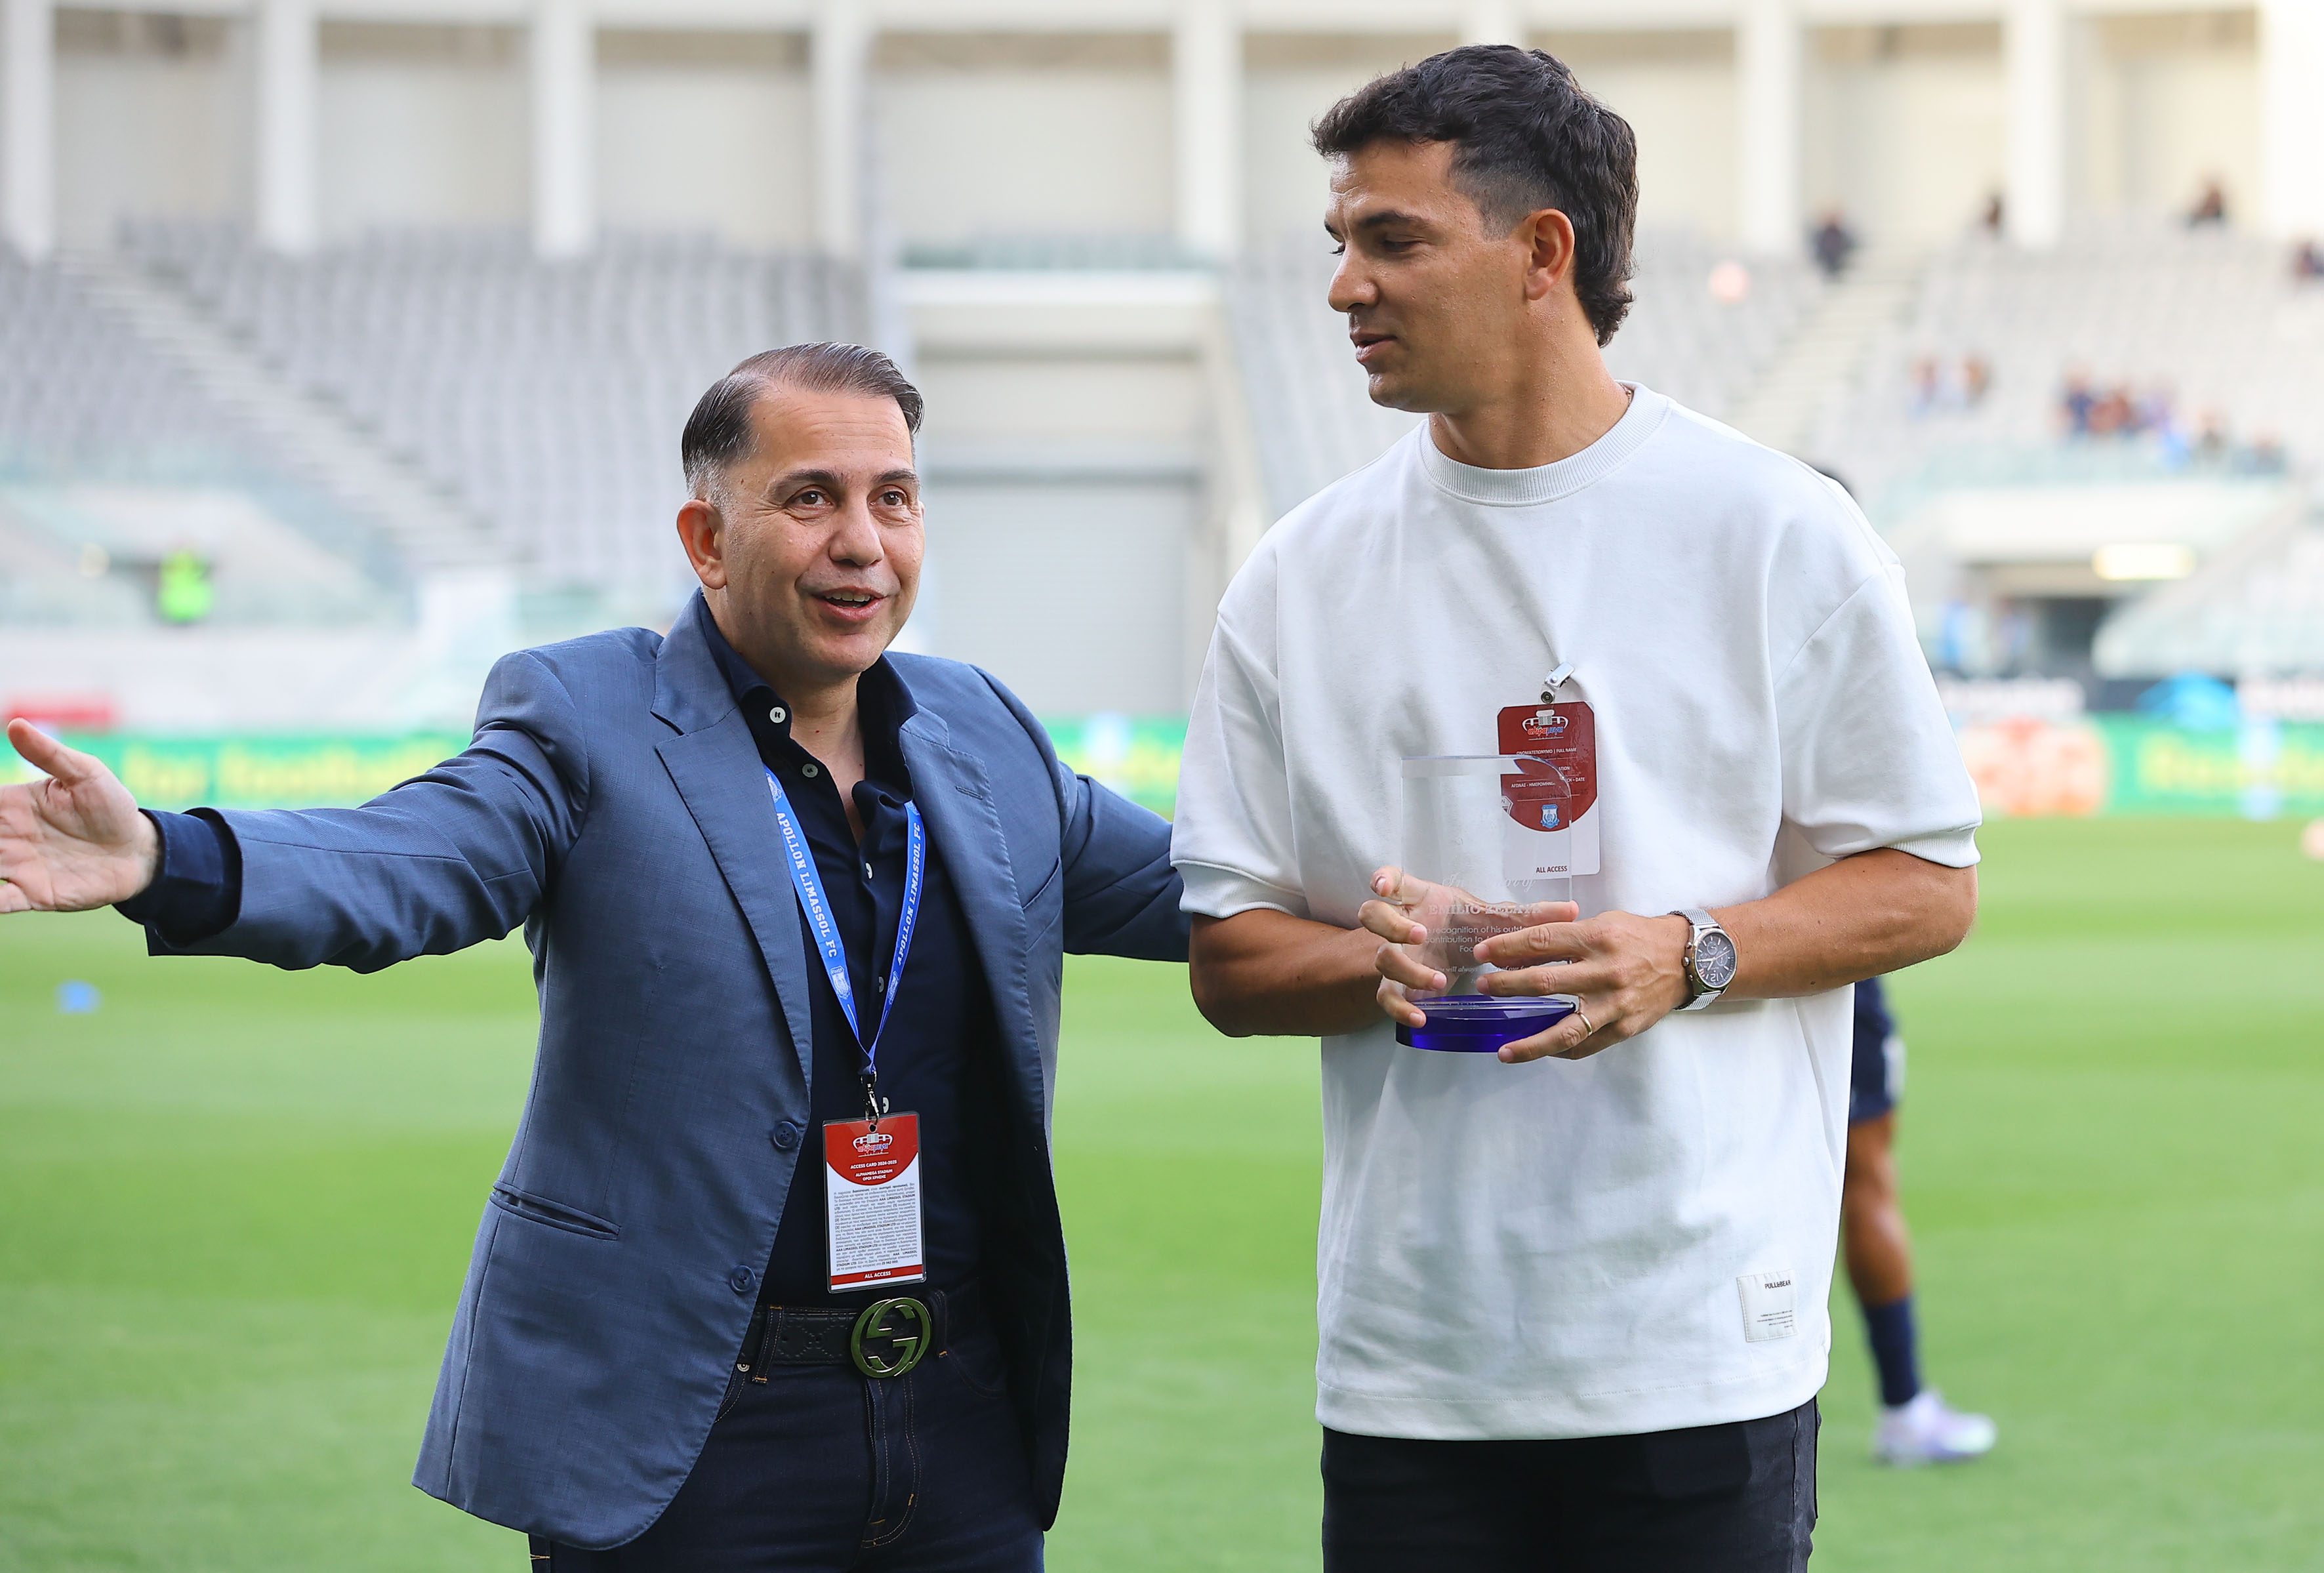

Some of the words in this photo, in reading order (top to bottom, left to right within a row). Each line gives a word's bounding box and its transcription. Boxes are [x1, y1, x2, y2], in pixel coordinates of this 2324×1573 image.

[914, 823, 921, 841] FC
[776, 812, 807, 870] APOLLON
[799, 872, 831, 938] LIMASSOL
[825, 939, 838, 958] FC
[908, 842, 921, 906] LIMASSOL
[897, 905, 914, 966] APOLLON
[1433, 926, 1478, 935] recognition
[1764, 1279, 1791, 1290] PULL&BEAR
